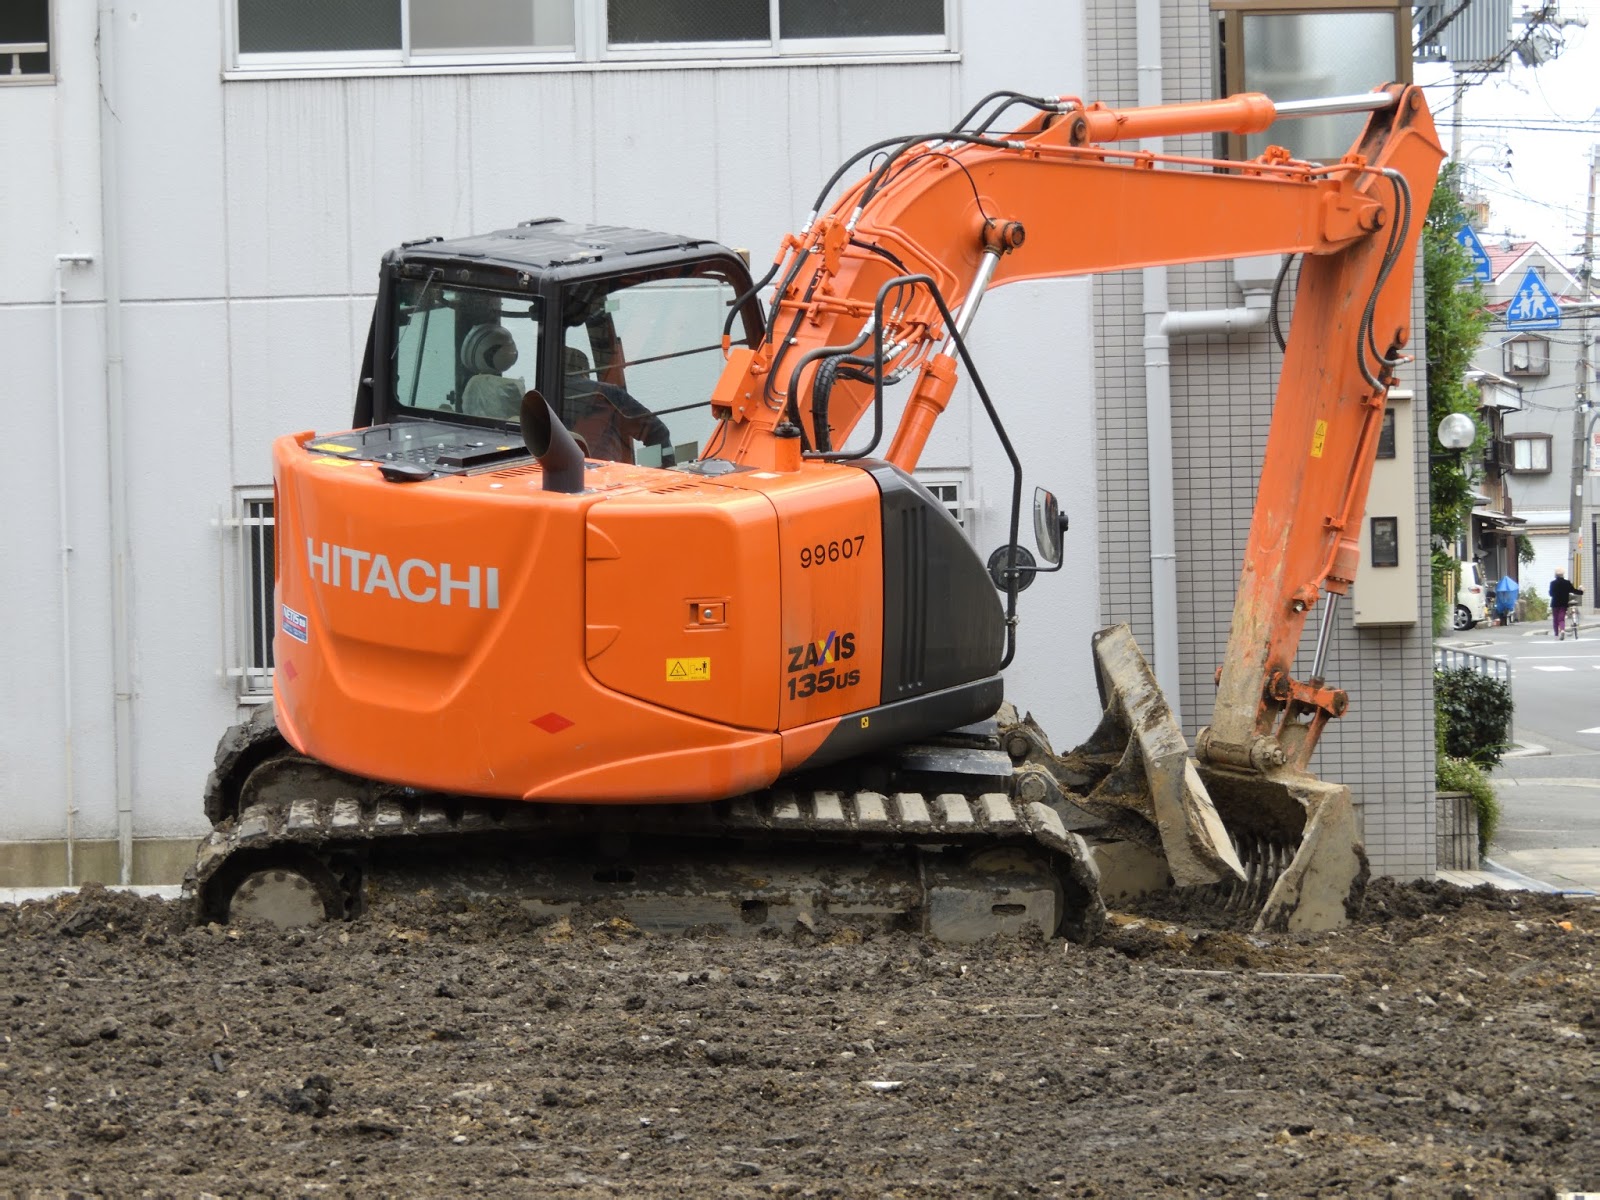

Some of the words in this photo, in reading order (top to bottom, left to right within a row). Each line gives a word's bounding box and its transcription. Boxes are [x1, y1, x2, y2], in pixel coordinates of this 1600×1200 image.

[306, 537, 500, 610] HITACHI
[800, 535, 865, 569] 99607
[787, 630, 856, 674] ZAXIS
